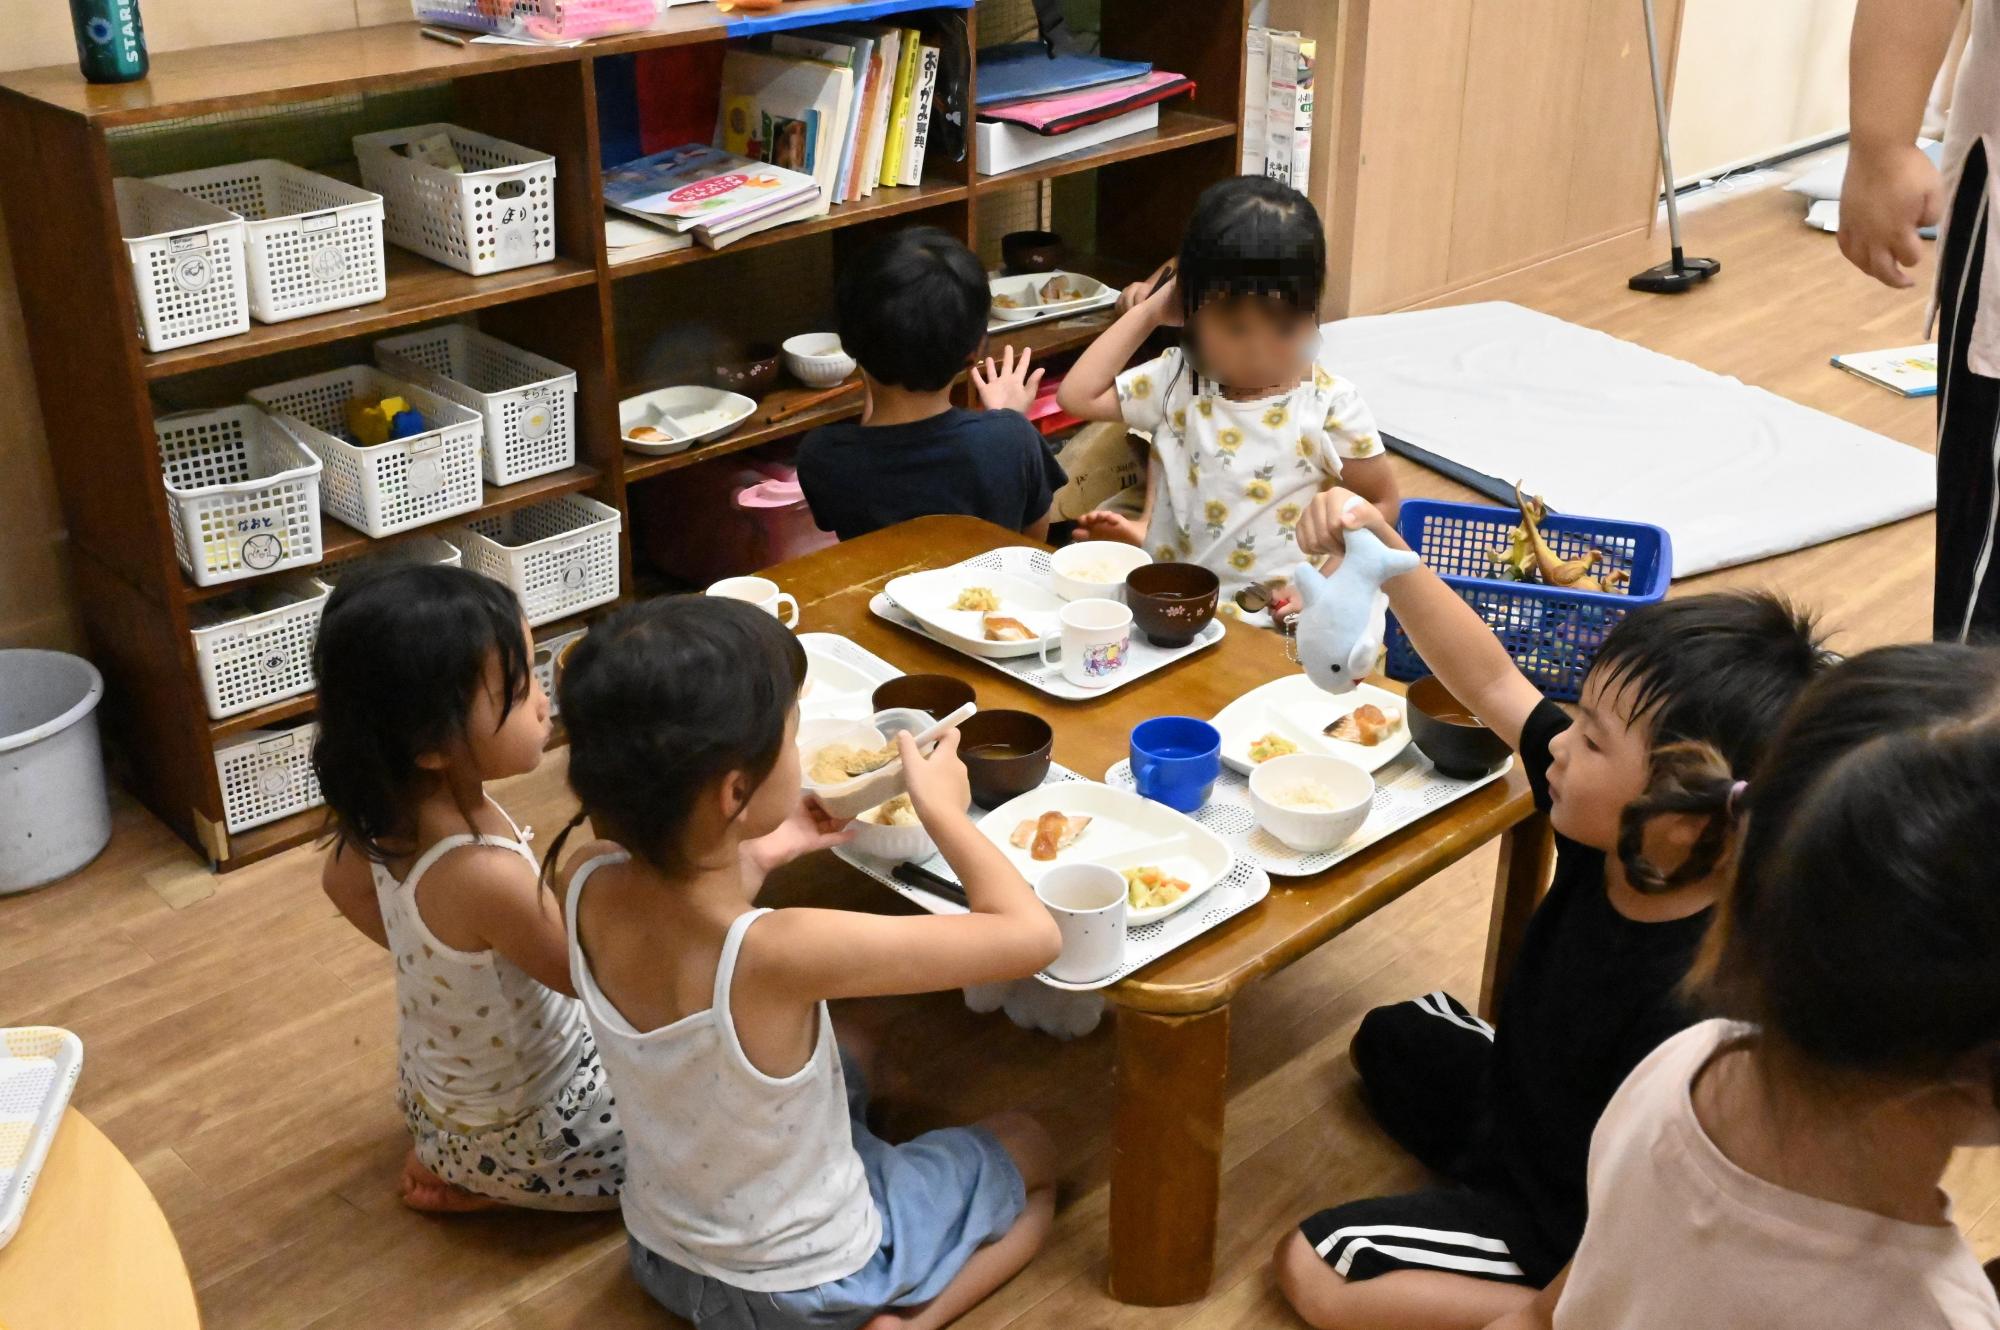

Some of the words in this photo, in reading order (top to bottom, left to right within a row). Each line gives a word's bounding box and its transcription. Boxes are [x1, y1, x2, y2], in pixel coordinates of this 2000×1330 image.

[914, 51, 937, 148] おりがみ事典
[238, 517, 272, 531] なおと
